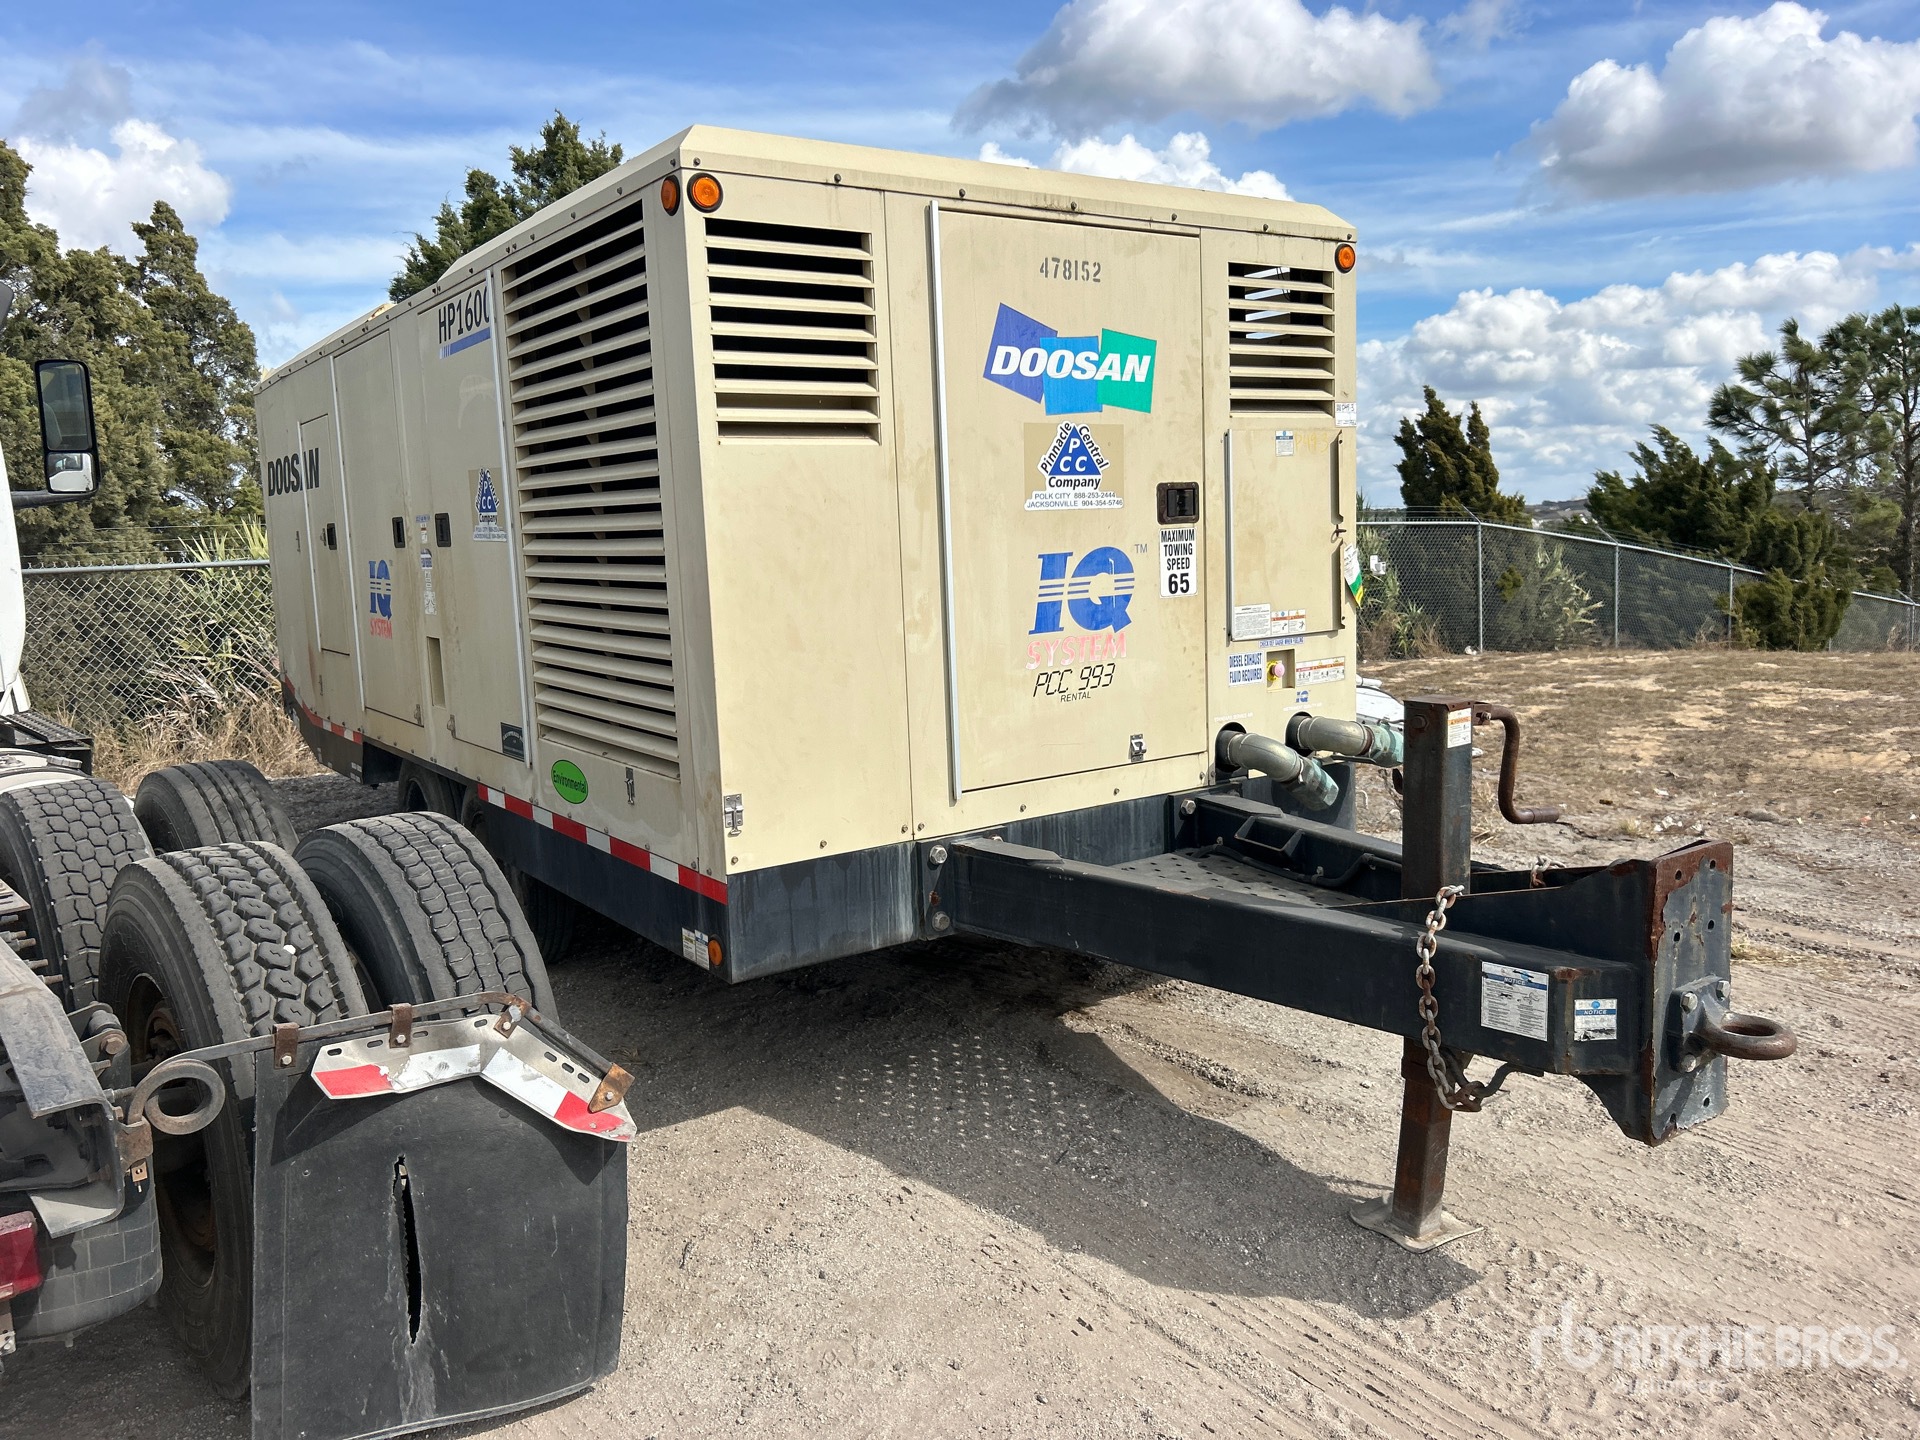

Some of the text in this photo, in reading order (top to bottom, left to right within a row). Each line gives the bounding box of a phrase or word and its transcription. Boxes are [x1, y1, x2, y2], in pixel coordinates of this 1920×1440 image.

[1039, 257, 1102, 283] 478152
[990, 344, 1152, 383] DOOSAN
[1040, 422, 1072, 474] Pinnacle
[1068, 438, 1081, 454] P
[1078, 425, 1110, 469] Central
[267, 447, 320, 497] DOOSAN
[1048, 476, 1102, 491] Company
[1034, 492, 1054, 500] POLK
[1073, 491, 1116, 499] 888-253-2444
[1027, 500, 1079, 508] JACKSONVILLE
[1161, 529, 1195, 543] MAXIMUM
[1163, 543, 1193, 557] TOWING
[1166, 557, 1190, 571] SPEED
[1028, 543, 1148, 635] IQ TM
[1168, 573, 1190, 594] 65
[369, 617, 393, 640] SYSTEM
[1025, 632, 1127, 670] SYSTEM
[1229, 652, 1262, 668] DIESEL EXHAUST
[1033, 663, 1116, 697] PCC 993
[1229, 671, 1241, 683] FLUID
[1241, 668, 1262, 681] REQUIRED
[1060, 691, 1091, 703] RENTAL
[1503, 976, 1526, 986] NOTICE
